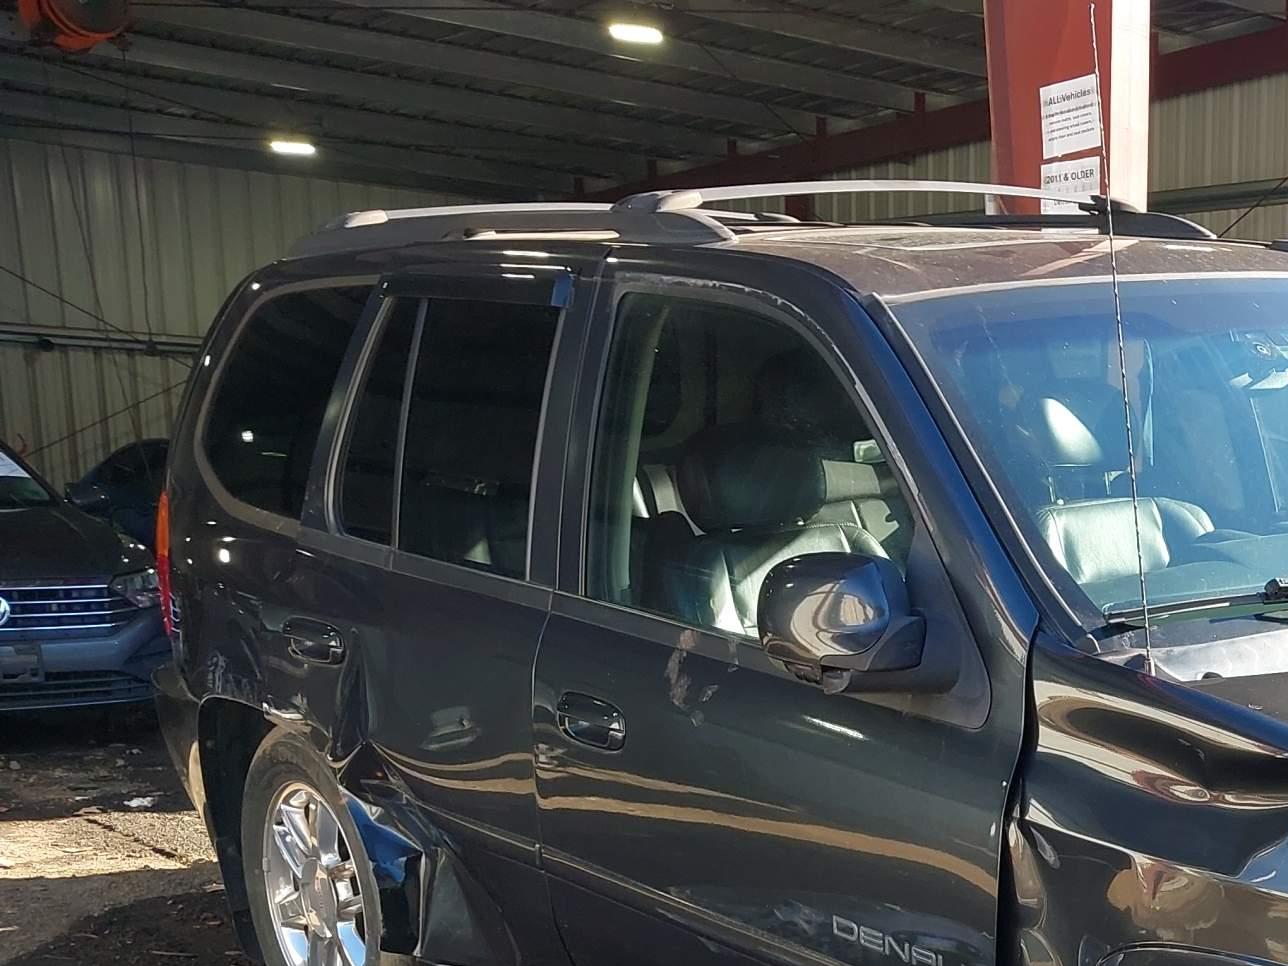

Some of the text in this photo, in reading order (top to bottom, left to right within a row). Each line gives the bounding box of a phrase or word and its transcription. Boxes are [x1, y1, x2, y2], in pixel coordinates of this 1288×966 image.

[1046, 168, 1095, 184] 2011 & OLDER
